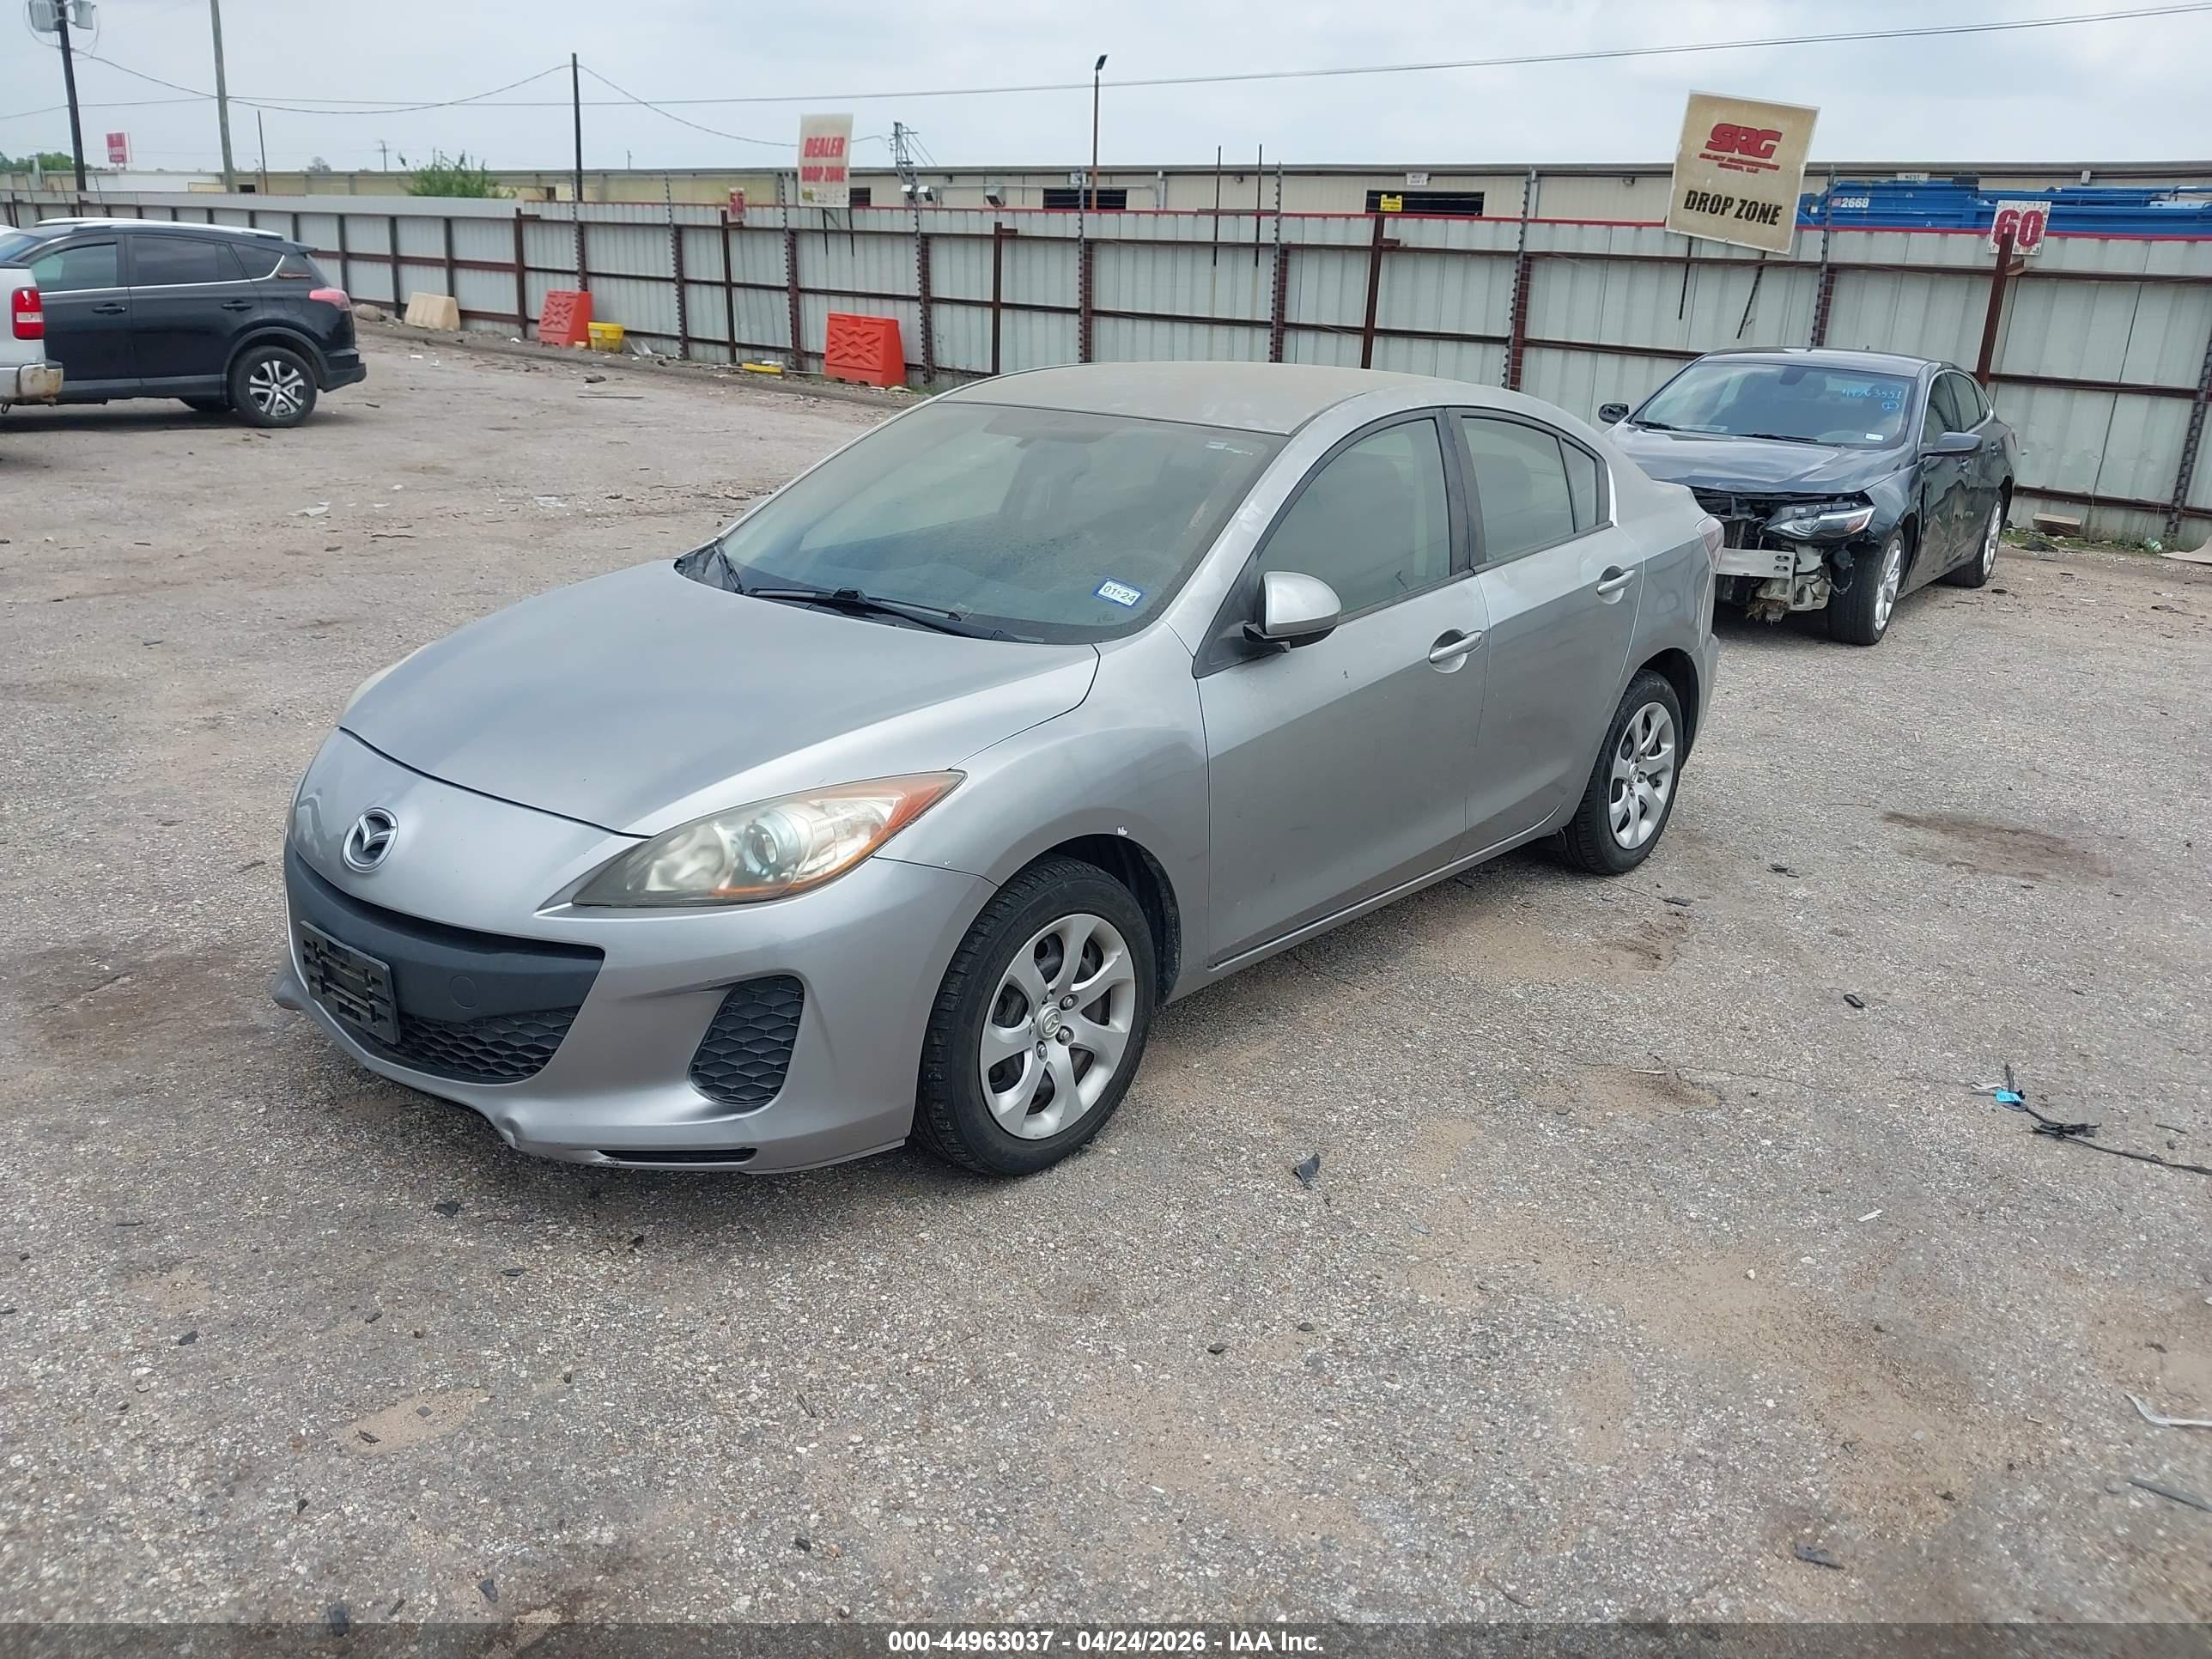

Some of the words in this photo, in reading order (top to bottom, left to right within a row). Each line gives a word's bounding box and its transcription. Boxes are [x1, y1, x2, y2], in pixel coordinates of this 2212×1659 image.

[804, 137, 845, 158] DEALER
[1705, 123, 1783, 159] SRG
[1683, 189, 1735, 216] DROP
[1733, 198, 1783, 226] ZONE
[1840, 197, 1869, 209] 2668
[1992, 209, 2044, 247] 60
